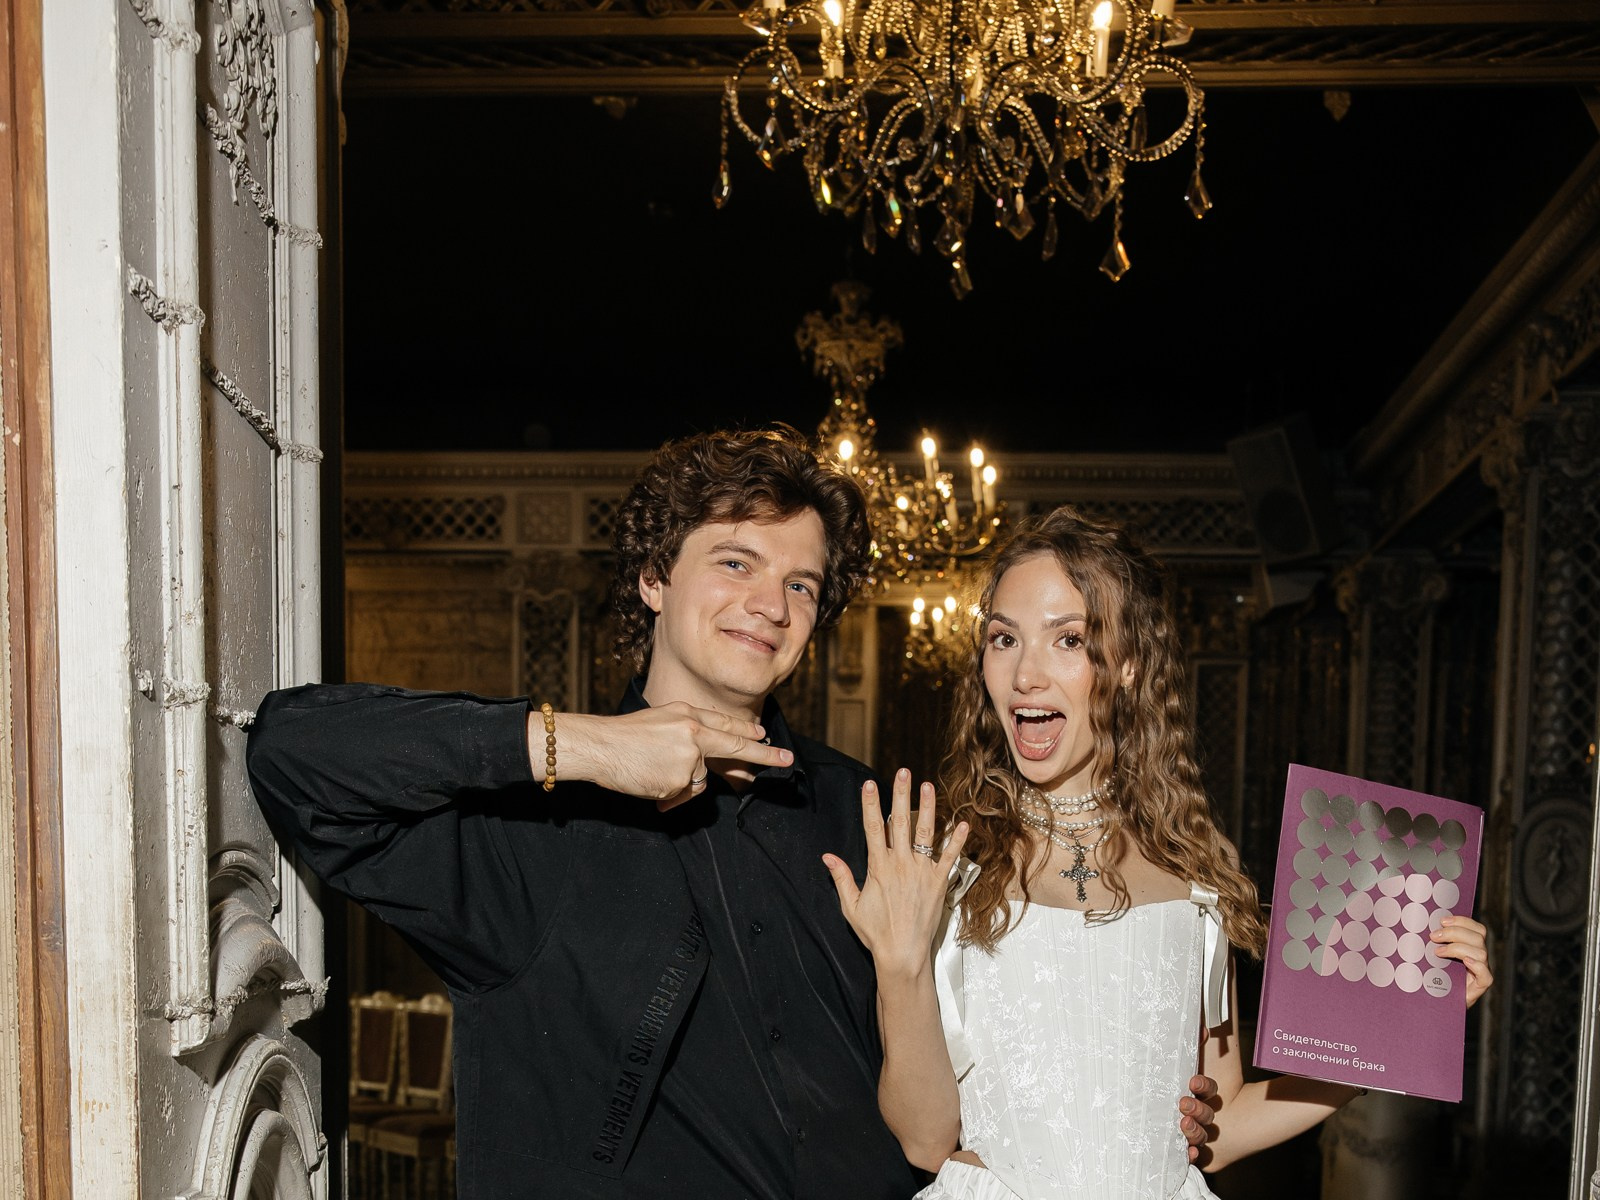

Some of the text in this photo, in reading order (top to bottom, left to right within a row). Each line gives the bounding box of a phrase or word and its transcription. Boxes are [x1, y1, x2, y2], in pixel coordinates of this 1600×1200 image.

[628, 964, 688, 1066] VETEMENTS
[1274, 1029, 1357, 1053] Свидетельство
[1273, 1046, 1385, 1072] о заключении брака
[592, 1070, 643, 1164] VETEMENTS
